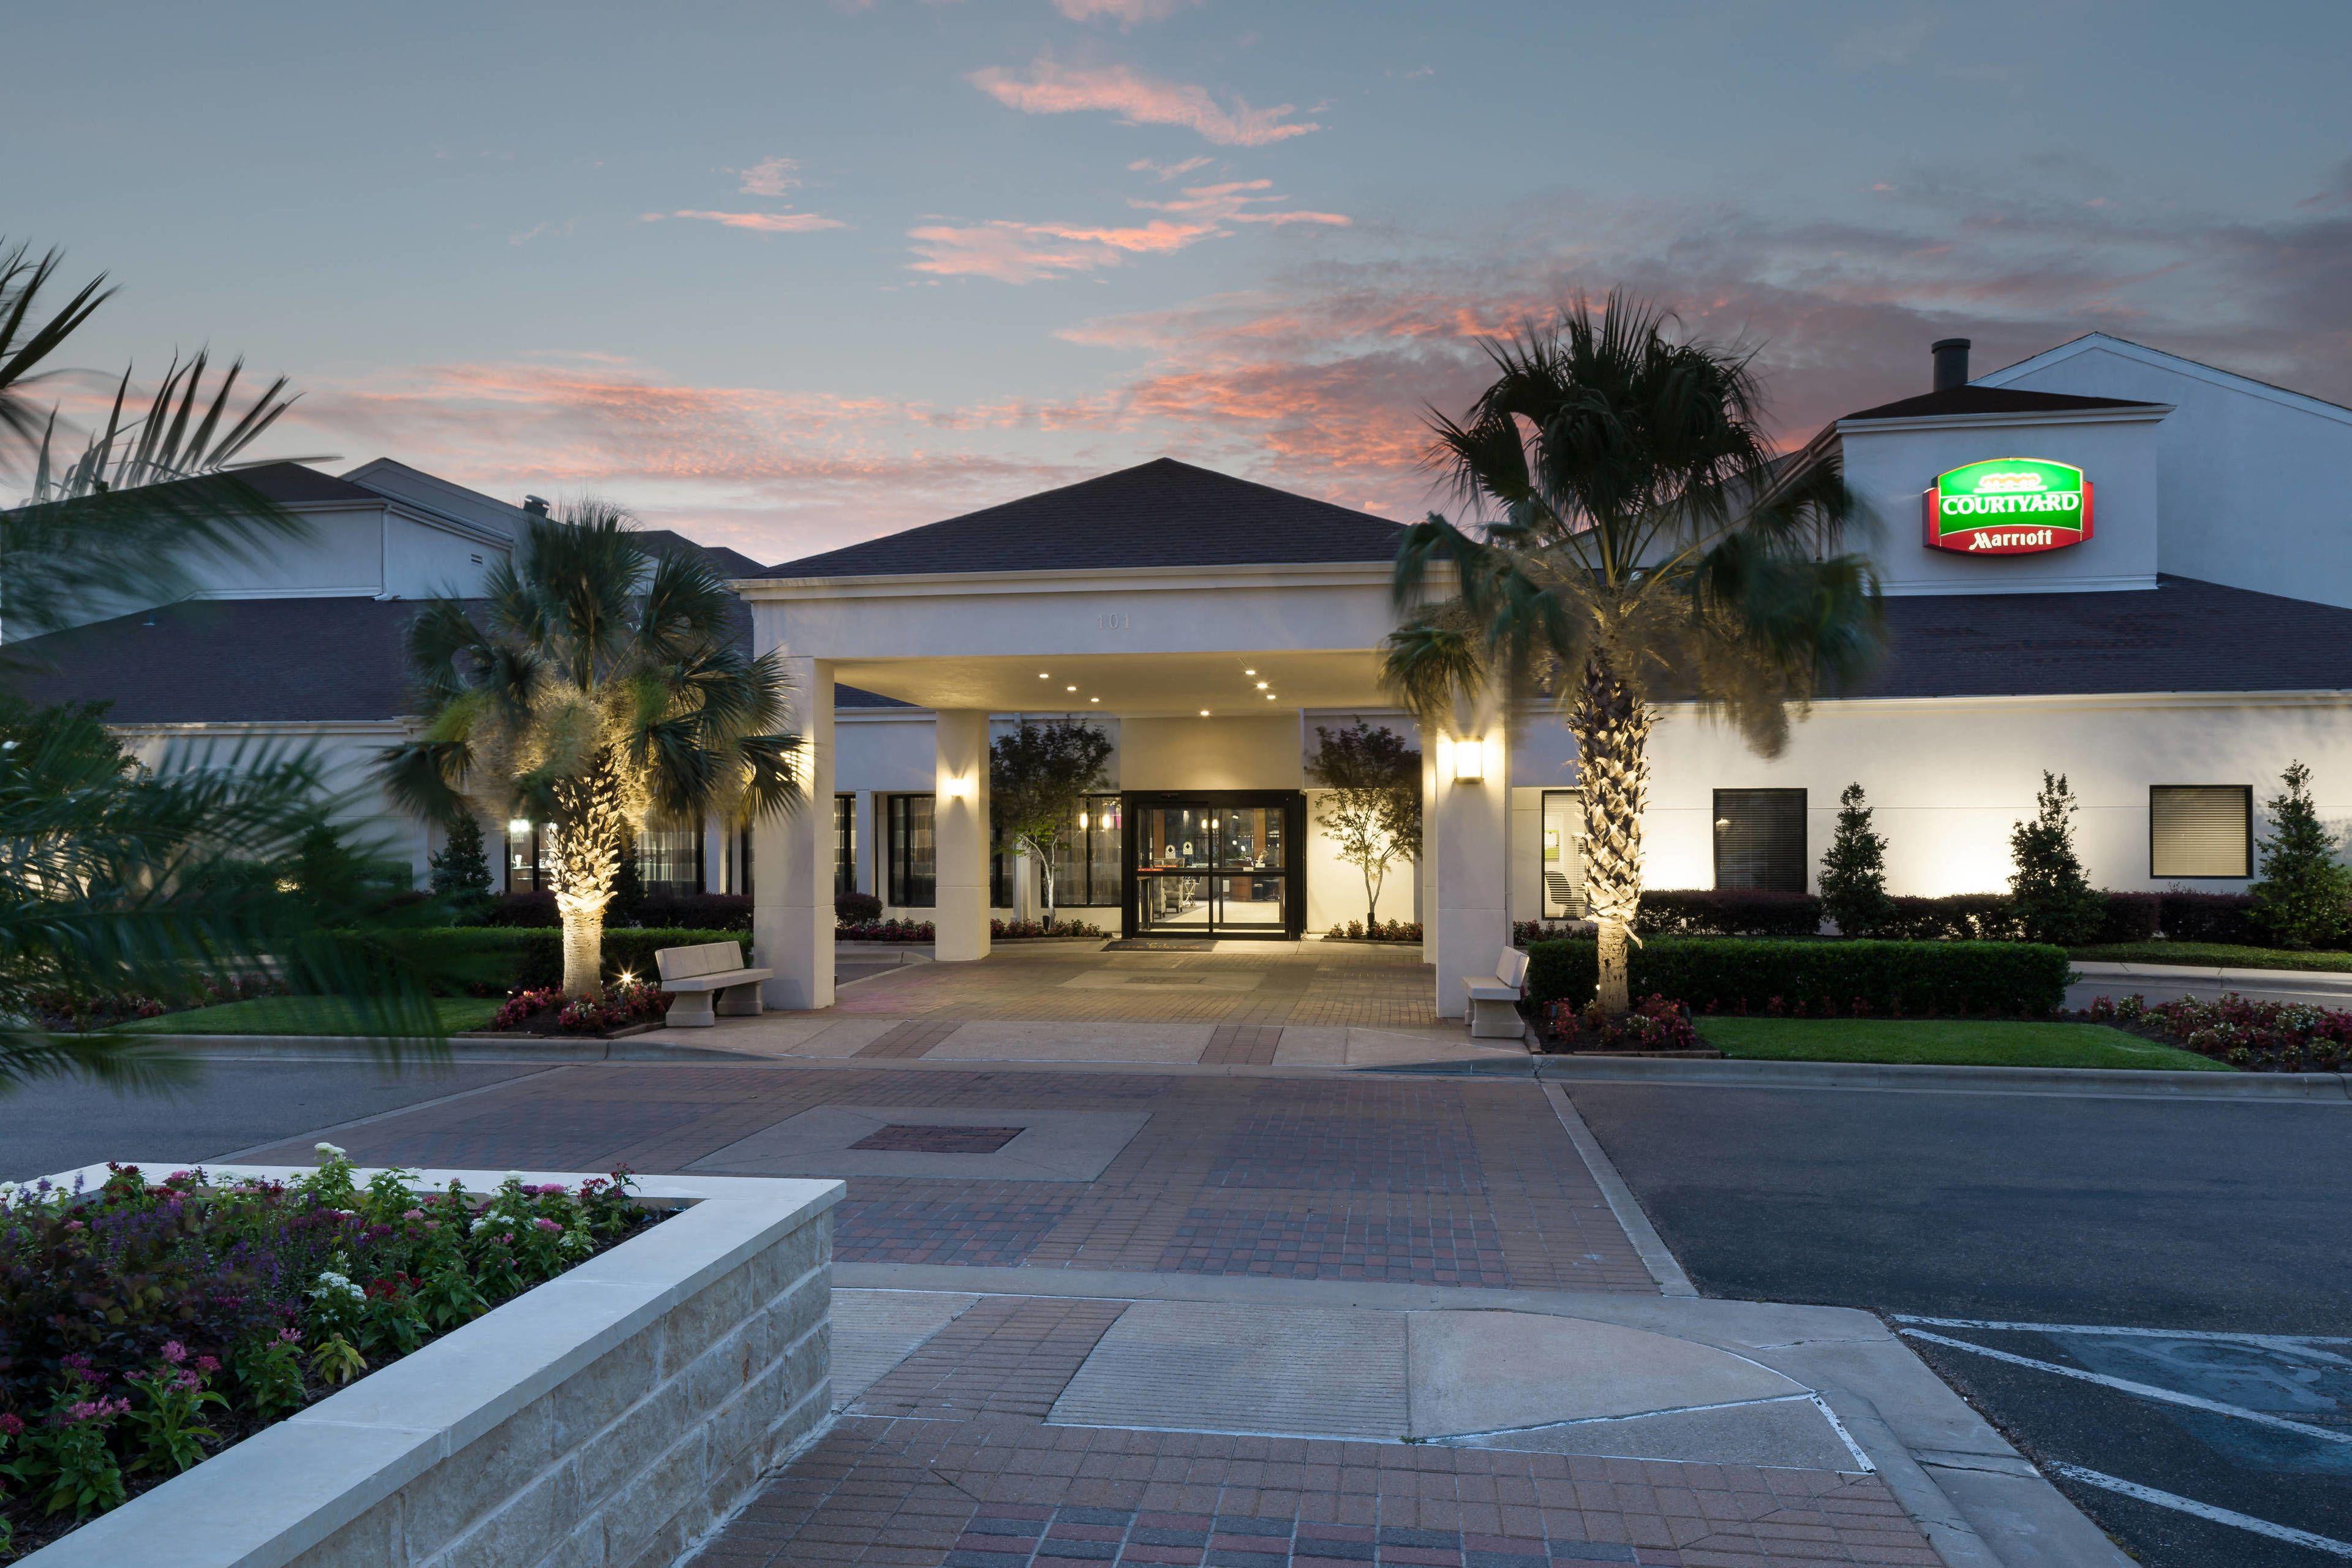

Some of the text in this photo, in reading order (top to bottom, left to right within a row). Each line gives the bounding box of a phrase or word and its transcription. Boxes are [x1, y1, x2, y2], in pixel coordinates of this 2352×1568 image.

[1942, 494, 2079, 514] COURTYARD
[1969, 530, 2052, 551] Marriott
[1097, 613, 1131, 630] 101
